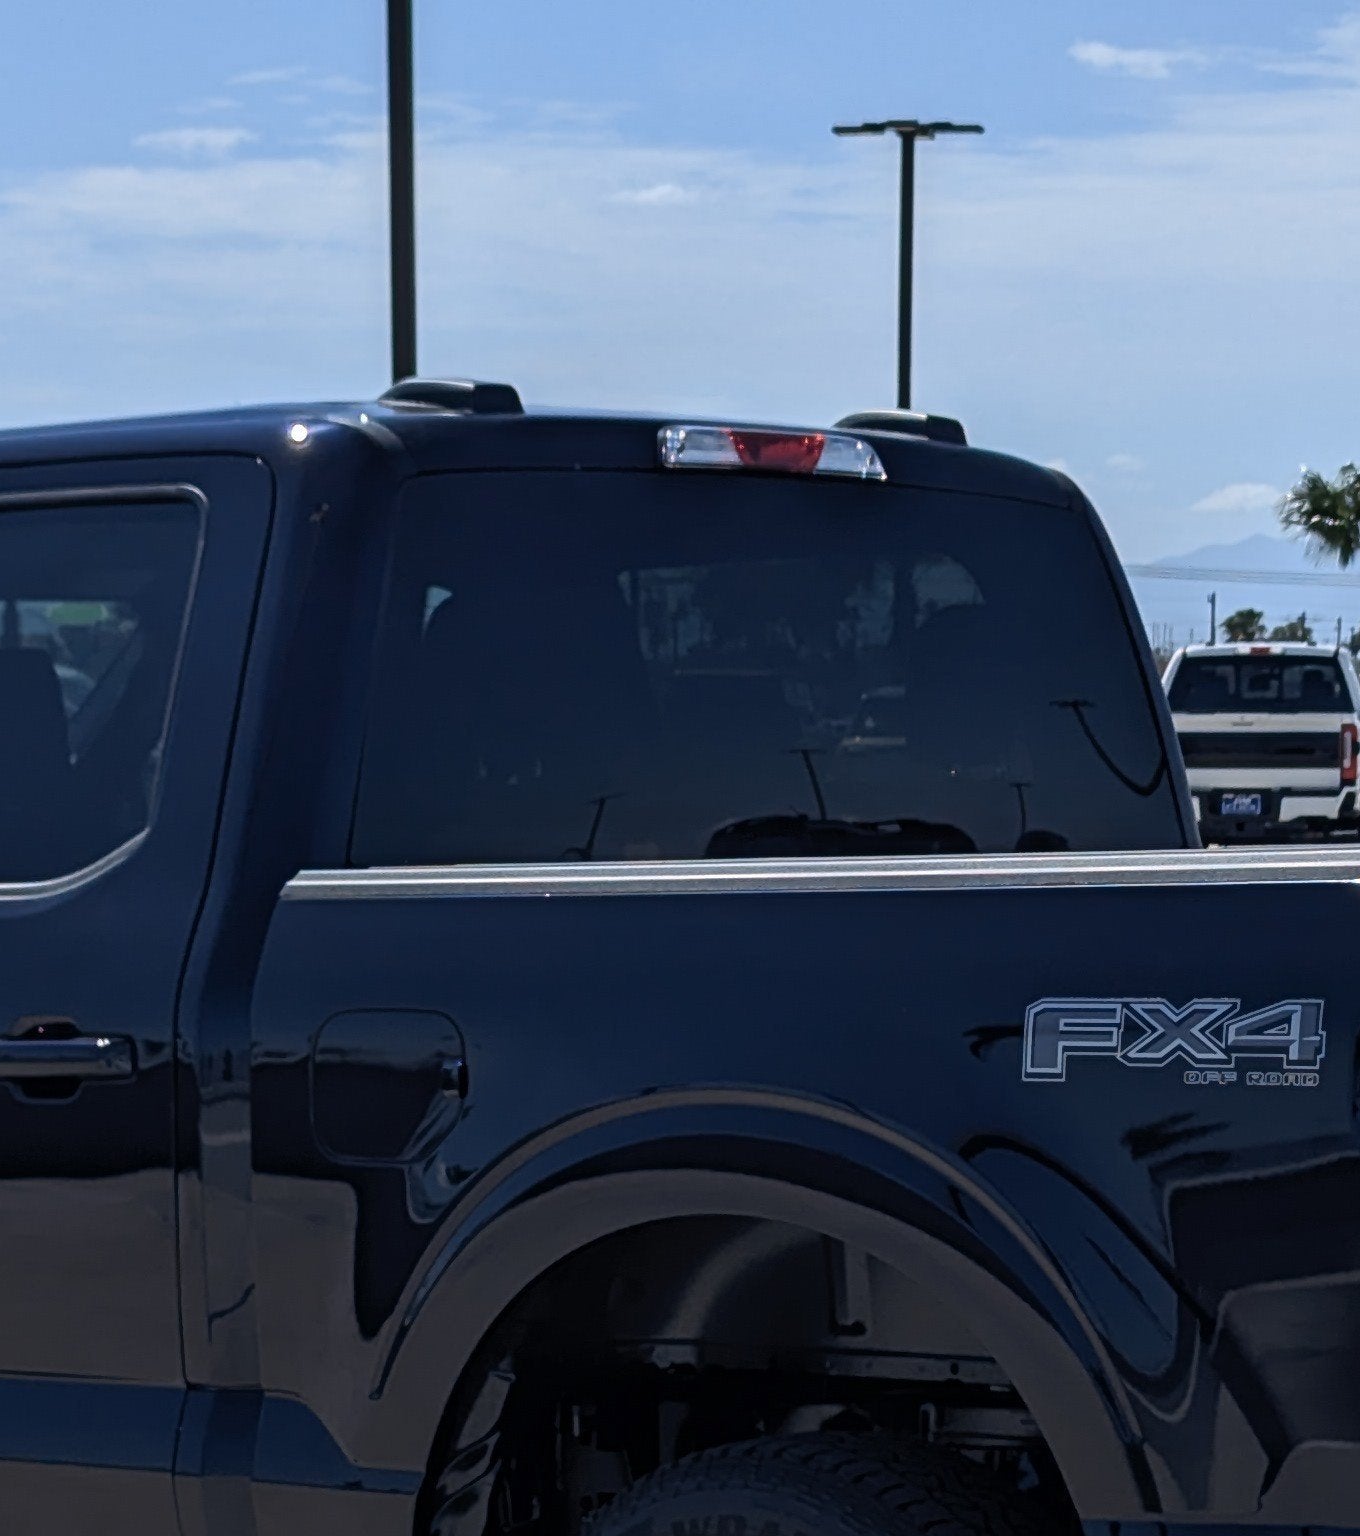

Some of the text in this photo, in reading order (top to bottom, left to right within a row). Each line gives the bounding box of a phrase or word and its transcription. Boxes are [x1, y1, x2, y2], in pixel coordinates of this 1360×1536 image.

[1022, 998, 1325, 1081] FX4
[1182, 1070, 1321, 1088] OFF ROAD
